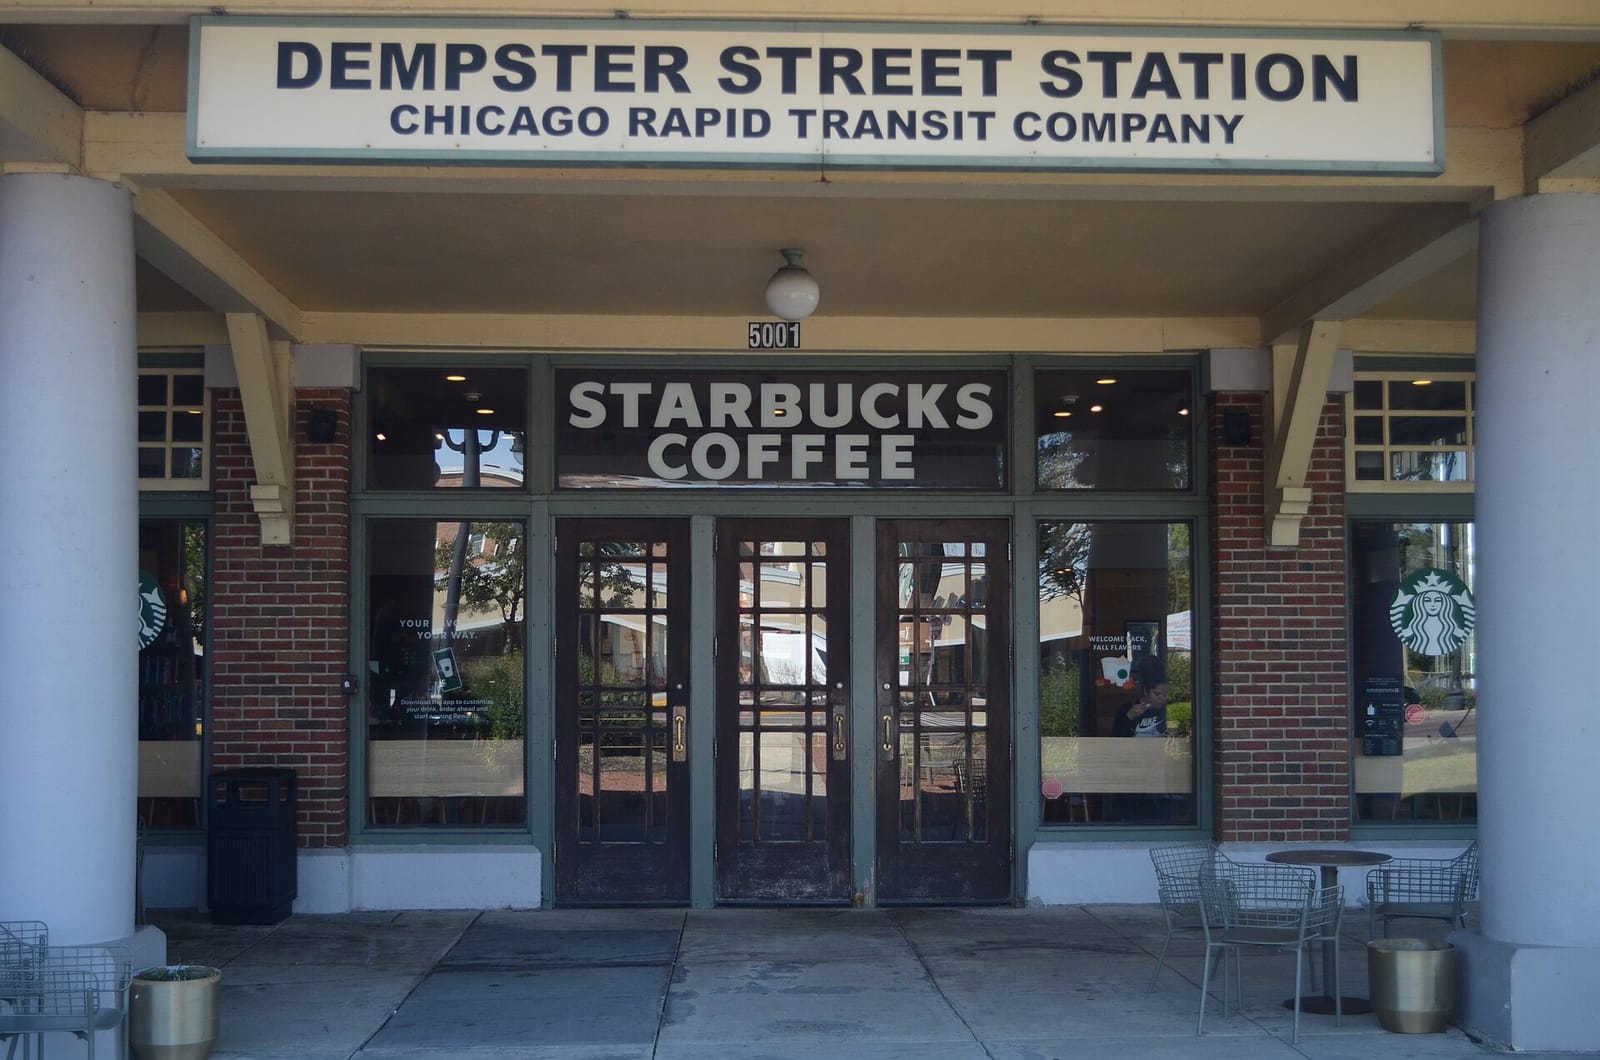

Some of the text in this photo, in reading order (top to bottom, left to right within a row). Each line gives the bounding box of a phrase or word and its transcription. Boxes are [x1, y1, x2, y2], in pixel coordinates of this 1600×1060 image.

[277, 41, 1359, 103] DEMPSTER STREET STATION
[390, 104, 1244, 145] CHICAGO RAPID TRANSIT COMPANY
[748, 322, 801, 348] 5001
[568, 381, 994, 429] STARBUCKS
[647, 432, 916, 481] COFFEE
[399, 619, 430, 628] YOUR
[450, 631, 478, 640] WAY.
[1088, 635, 1125, 643] WELCOME
[1092, 644, 1142, 652] FALL FLAVRS
